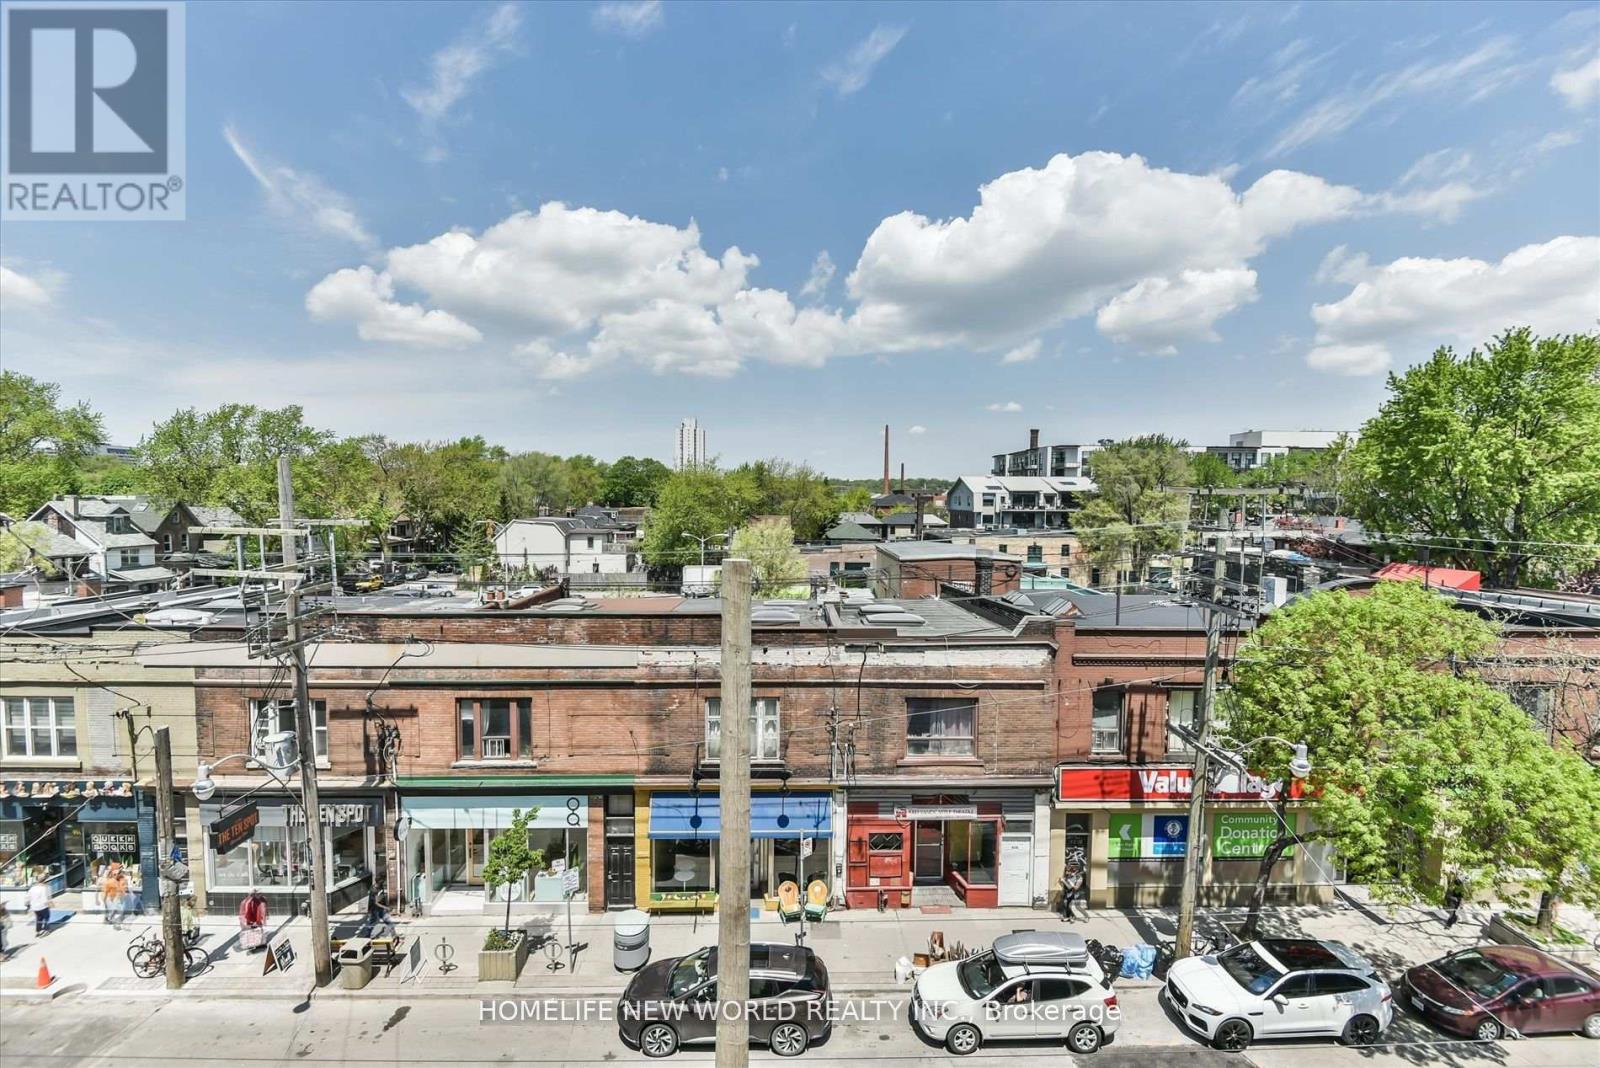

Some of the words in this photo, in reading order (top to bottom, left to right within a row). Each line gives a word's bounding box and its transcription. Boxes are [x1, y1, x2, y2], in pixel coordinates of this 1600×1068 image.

[1138, 770, 1193, 793] Valu
[319, 804, 334, 824] EN
[334, 804, 373, 825] SPOT
[1221, 814, 1278, 825] Community
[92, 834, 135, 842] QUEEN
[218, 830, 231, 846] THE
[231, 820, 243, 837] TEN
[92, 843, 135, 851] BOOKS
[1220, 841, 1267, 854] Centr
